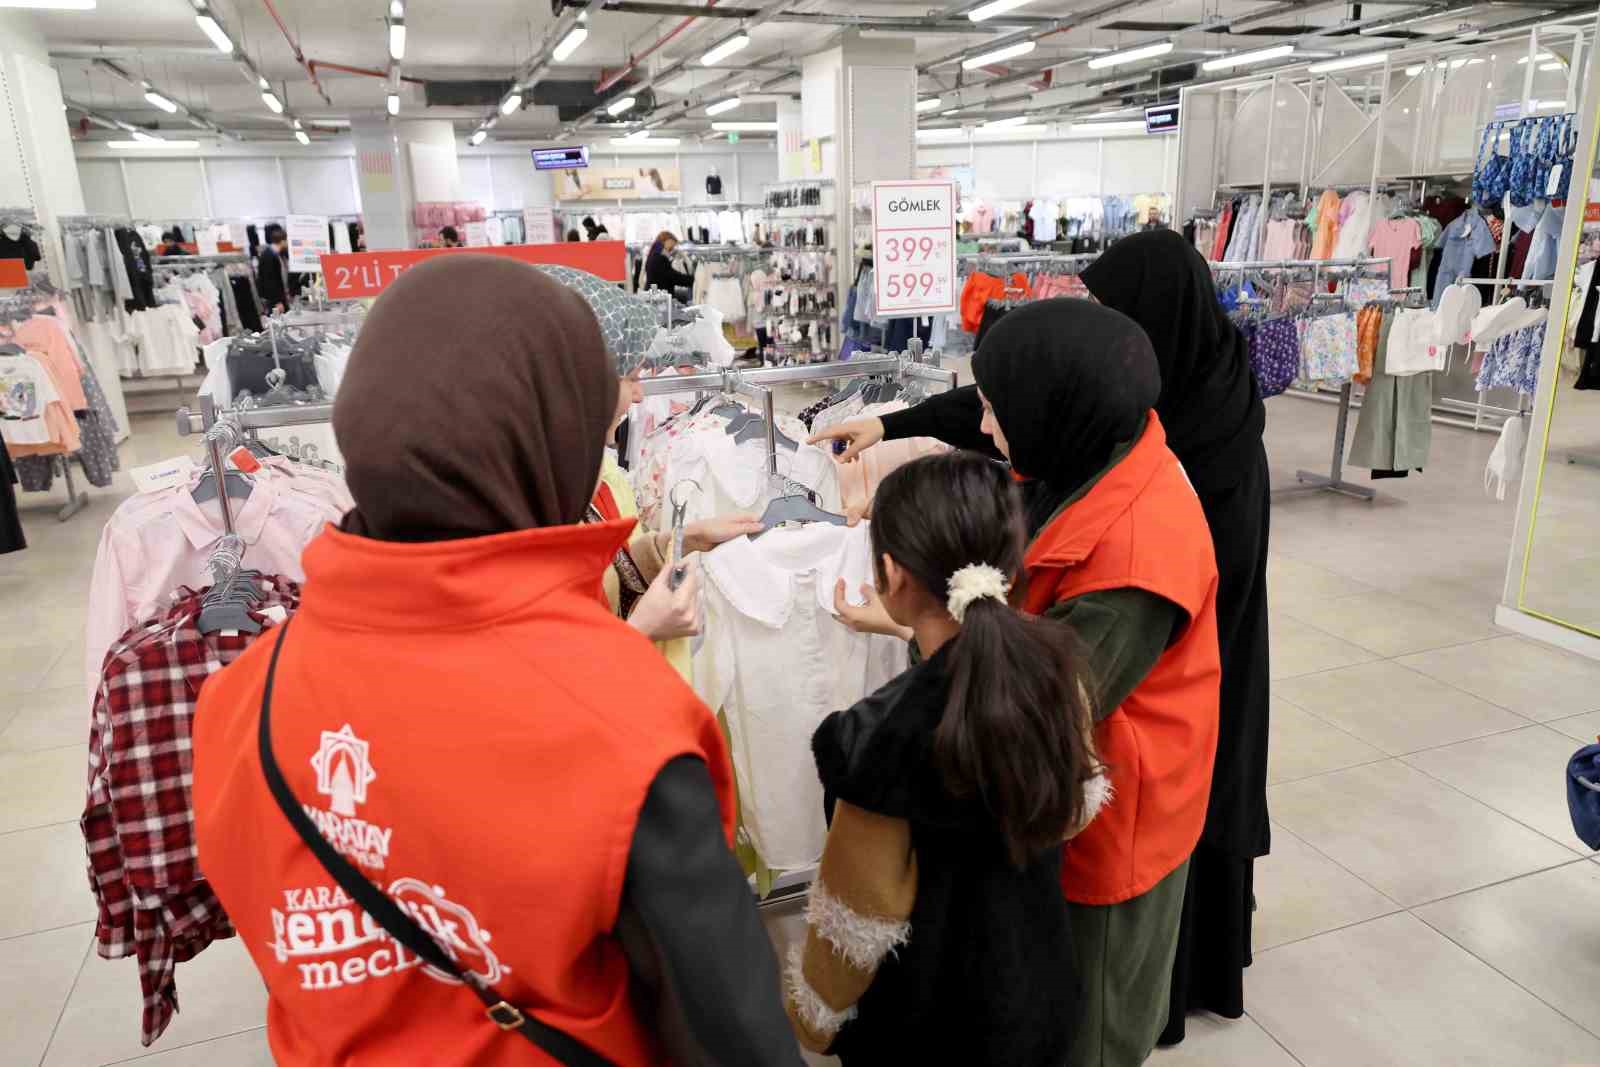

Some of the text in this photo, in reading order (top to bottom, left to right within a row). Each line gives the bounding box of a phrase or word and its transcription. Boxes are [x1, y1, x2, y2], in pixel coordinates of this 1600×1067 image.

[888, 197, 941, 212] GÖMLEK
[885, 237, 934, 262] 399
[886, 272, 934, 298] 599
